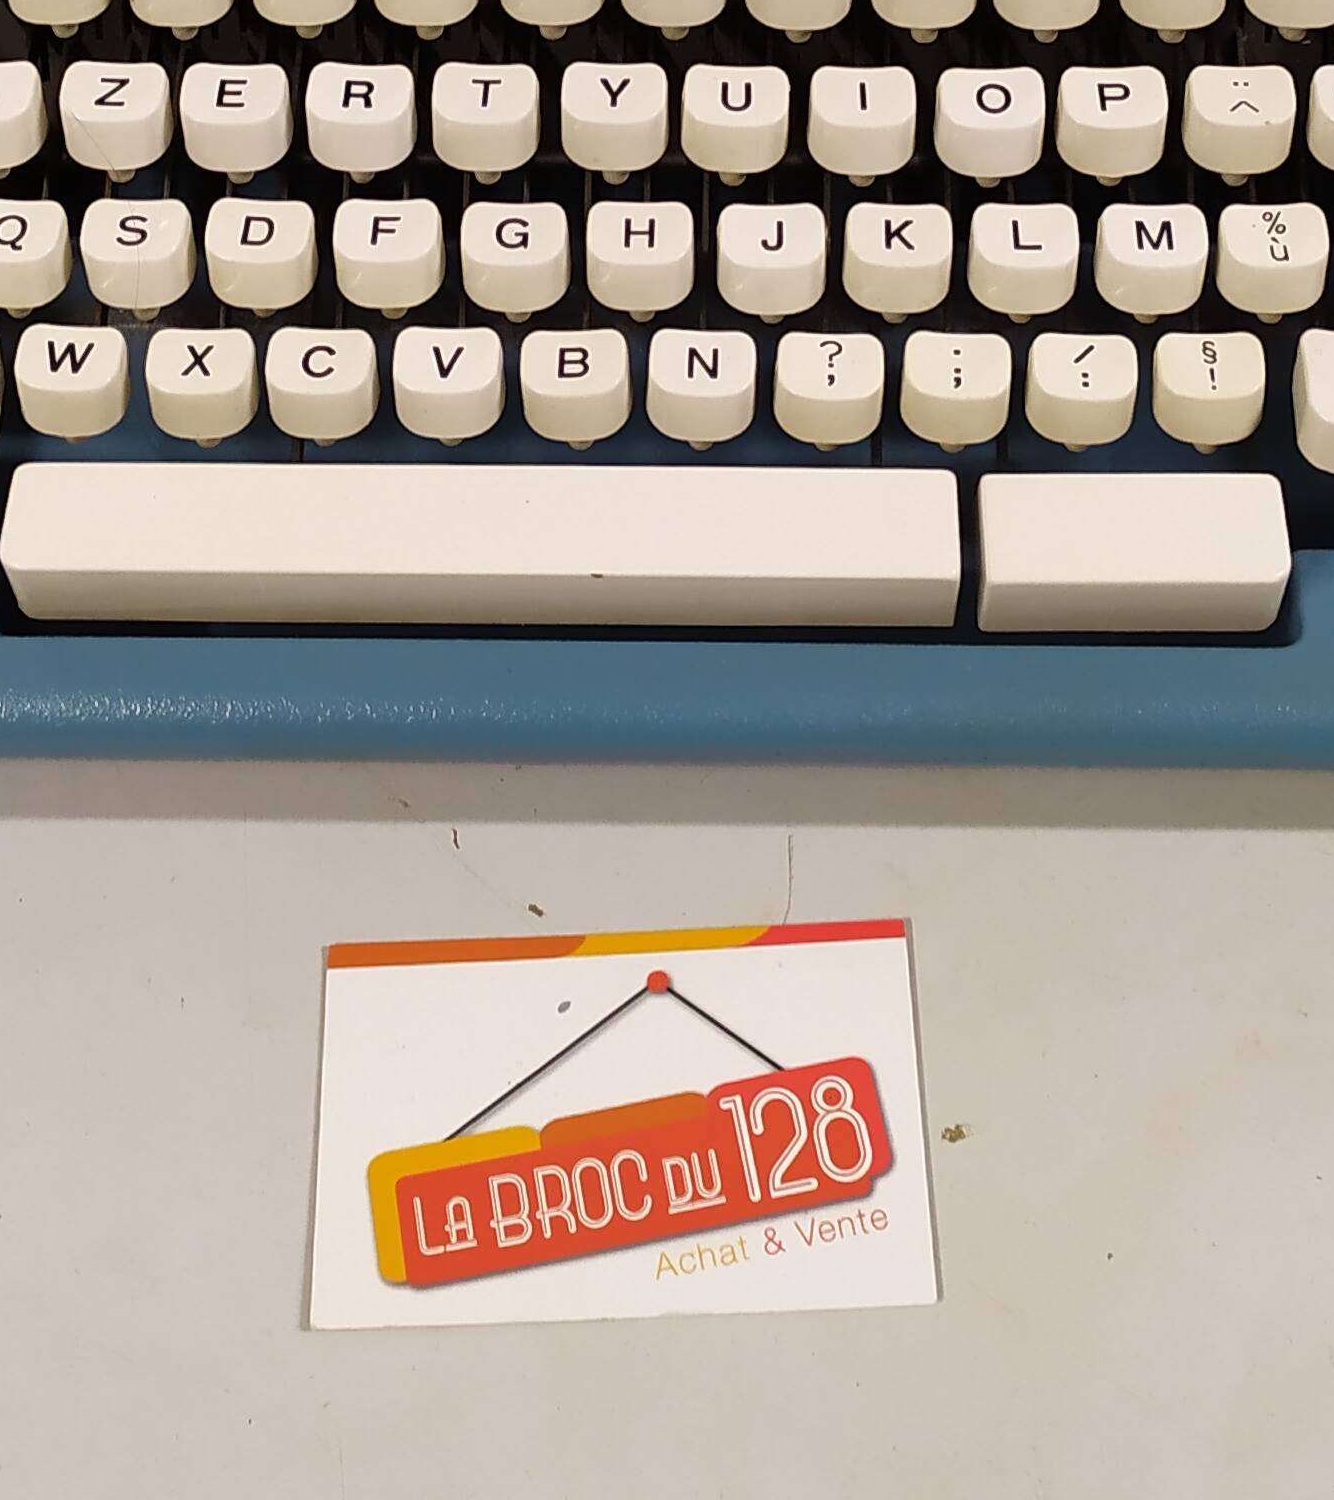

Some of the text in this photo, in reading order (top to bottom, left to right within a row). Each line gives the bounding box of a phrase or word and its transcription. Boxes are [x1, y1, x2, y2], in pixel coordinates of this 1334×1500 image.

[94, 78, 129, 107] Z
[216, 79, 247, 107] E
[342, 80, 374, 108] R
[472, 79, 501, 108] T
[600, 78, 630, 107] Y
[721, 82, 751, 111] U
[859, 82, 867, 111] I
[976, 83, 1011, 114] O
[1098, 83, 1130, 111] P
[116, 216, 147, 246] S
[240, 216, 274, 246] D
[371, 217, 401, 246] F
[496, 218, 529, 249] G
[624, 218, 655, 248] H
[761, 221, 784, 251] J
[885, 220, 914, 250] K
[1012, 220, 1042, 250] L
[1135, 221, 1173, 250] M
[1262, 211, 1286, 235] %
[1270, 237, 1289, 261] ù
[48, 341, 94, 374] W
[181, 345, 214, 377] X
[302, 346, 336, 378] C
[433, 346, 464, 378] V
[558, 347, 589, 378] B
[688, 347, 718, 379] N
[820, 341, 842, 368] ?
[413, 1075, 874, 1256] LA BROC DU 128
[655, 1205, 889, 1280] Achat & Vente
